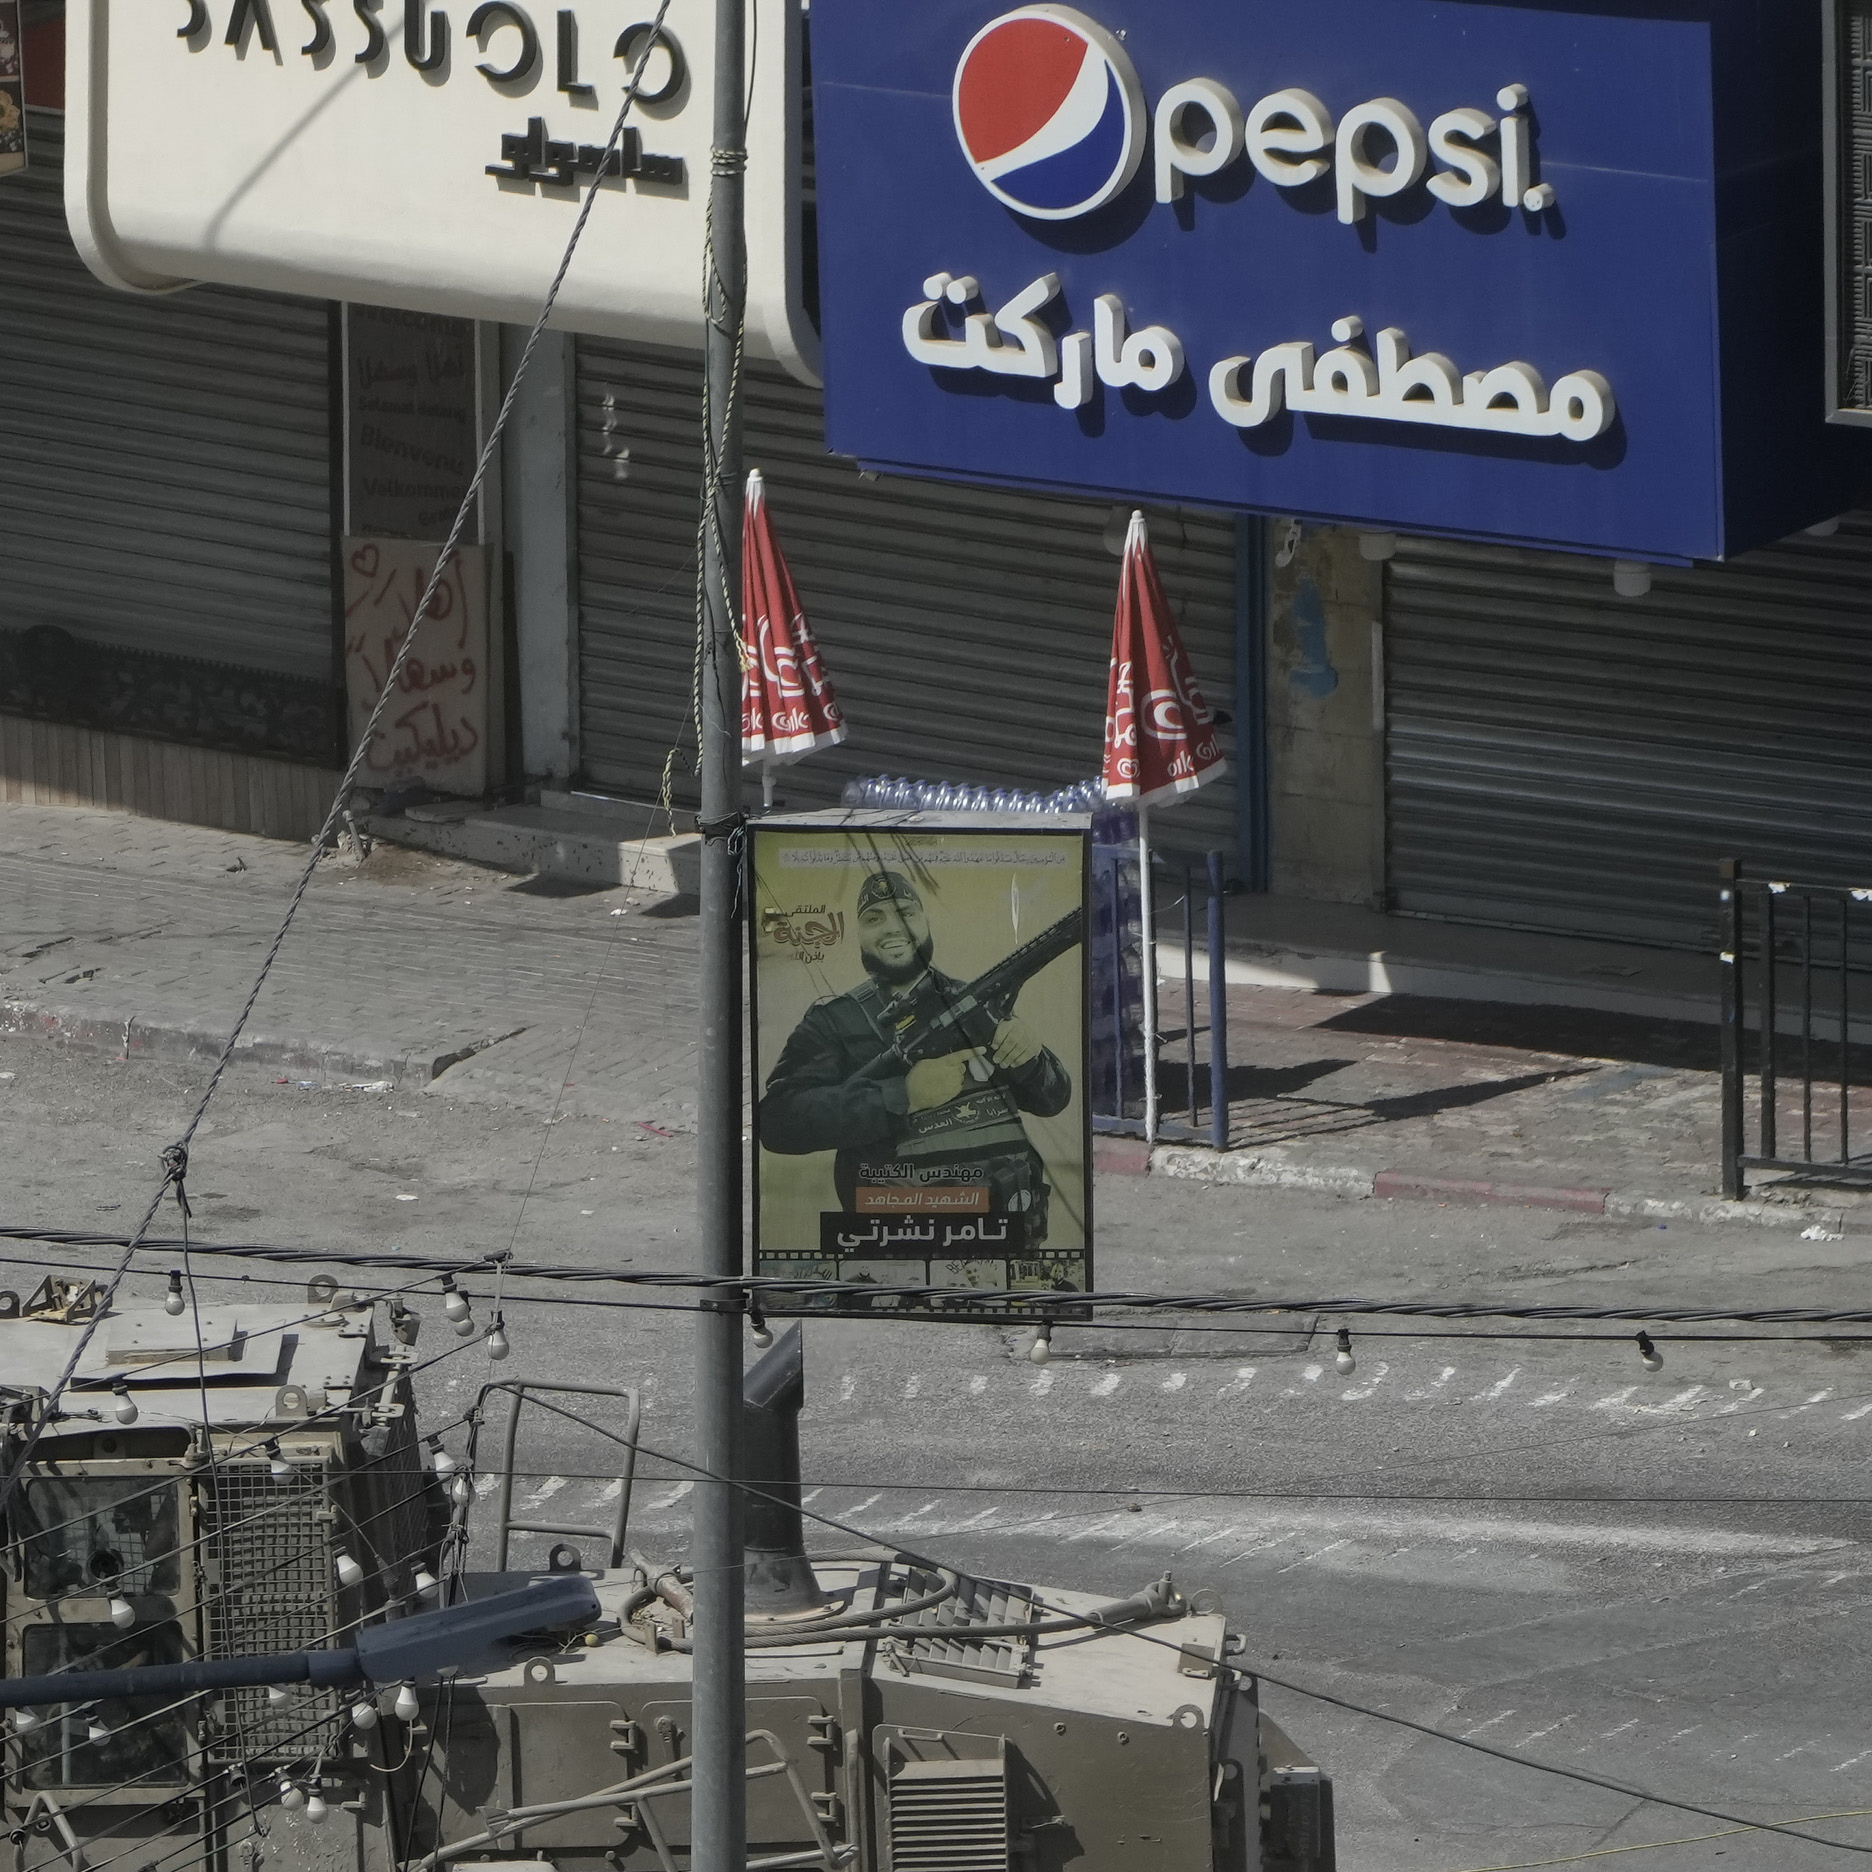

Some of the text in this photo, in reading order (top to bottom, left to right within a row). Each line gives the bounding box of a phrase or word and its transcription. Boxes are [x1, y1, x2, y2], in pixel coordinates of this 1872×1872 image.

[1152, 78, 1536, 224] pepsi
[900, 271, 1615, 442] مصطفى ماركت
[773, 911, 845, 948] الجنة
[859, 1163, 984, 1182] مهندس الكتيبة
[865, 1191, 980, 1209] الشهيد المجاهد
[837, 1215, 936, 1254] نشرتي
